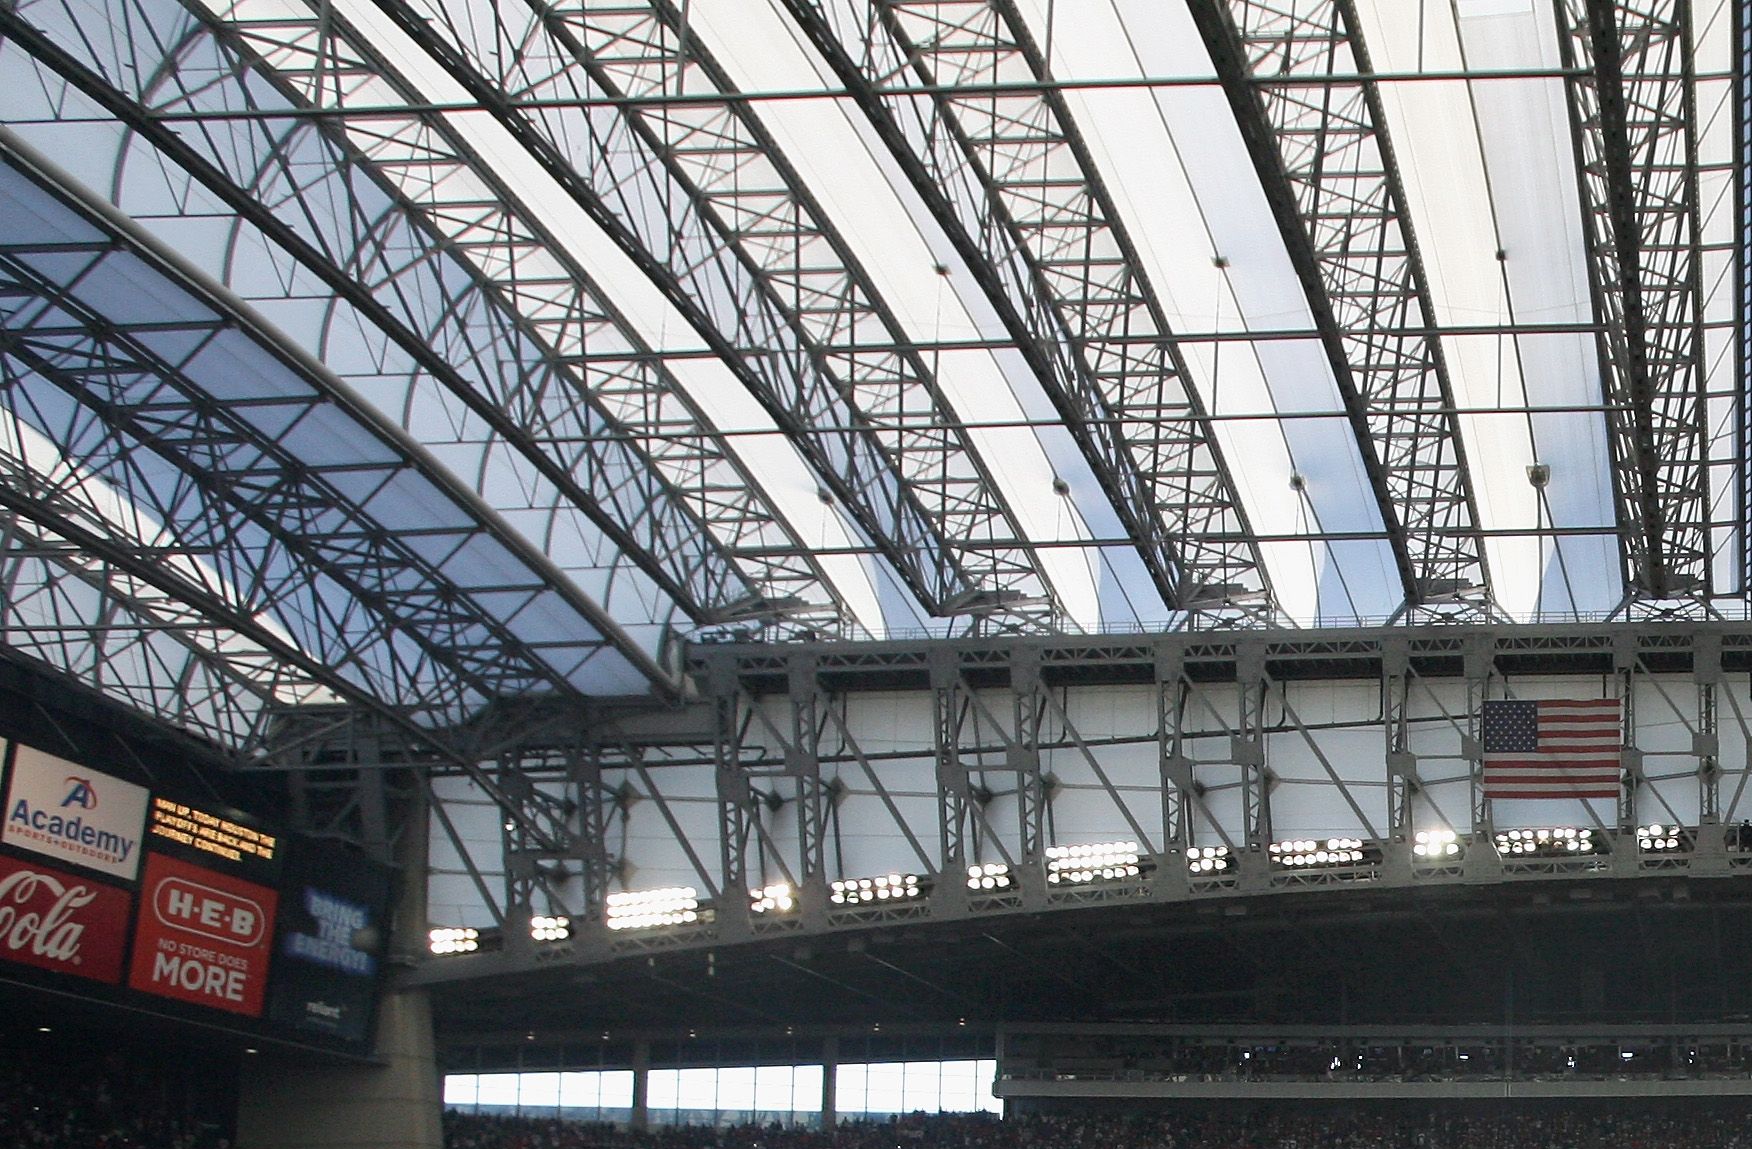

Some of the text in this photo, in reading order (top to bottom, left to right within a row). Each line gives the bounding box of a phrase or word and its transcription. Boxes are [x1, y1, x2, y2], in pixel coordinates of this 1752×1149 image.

[10, 798, 134, 863] Academy
[152, 951, 247, 1001] MORE
[158, 936, 249, 971] NO STORE DOES
